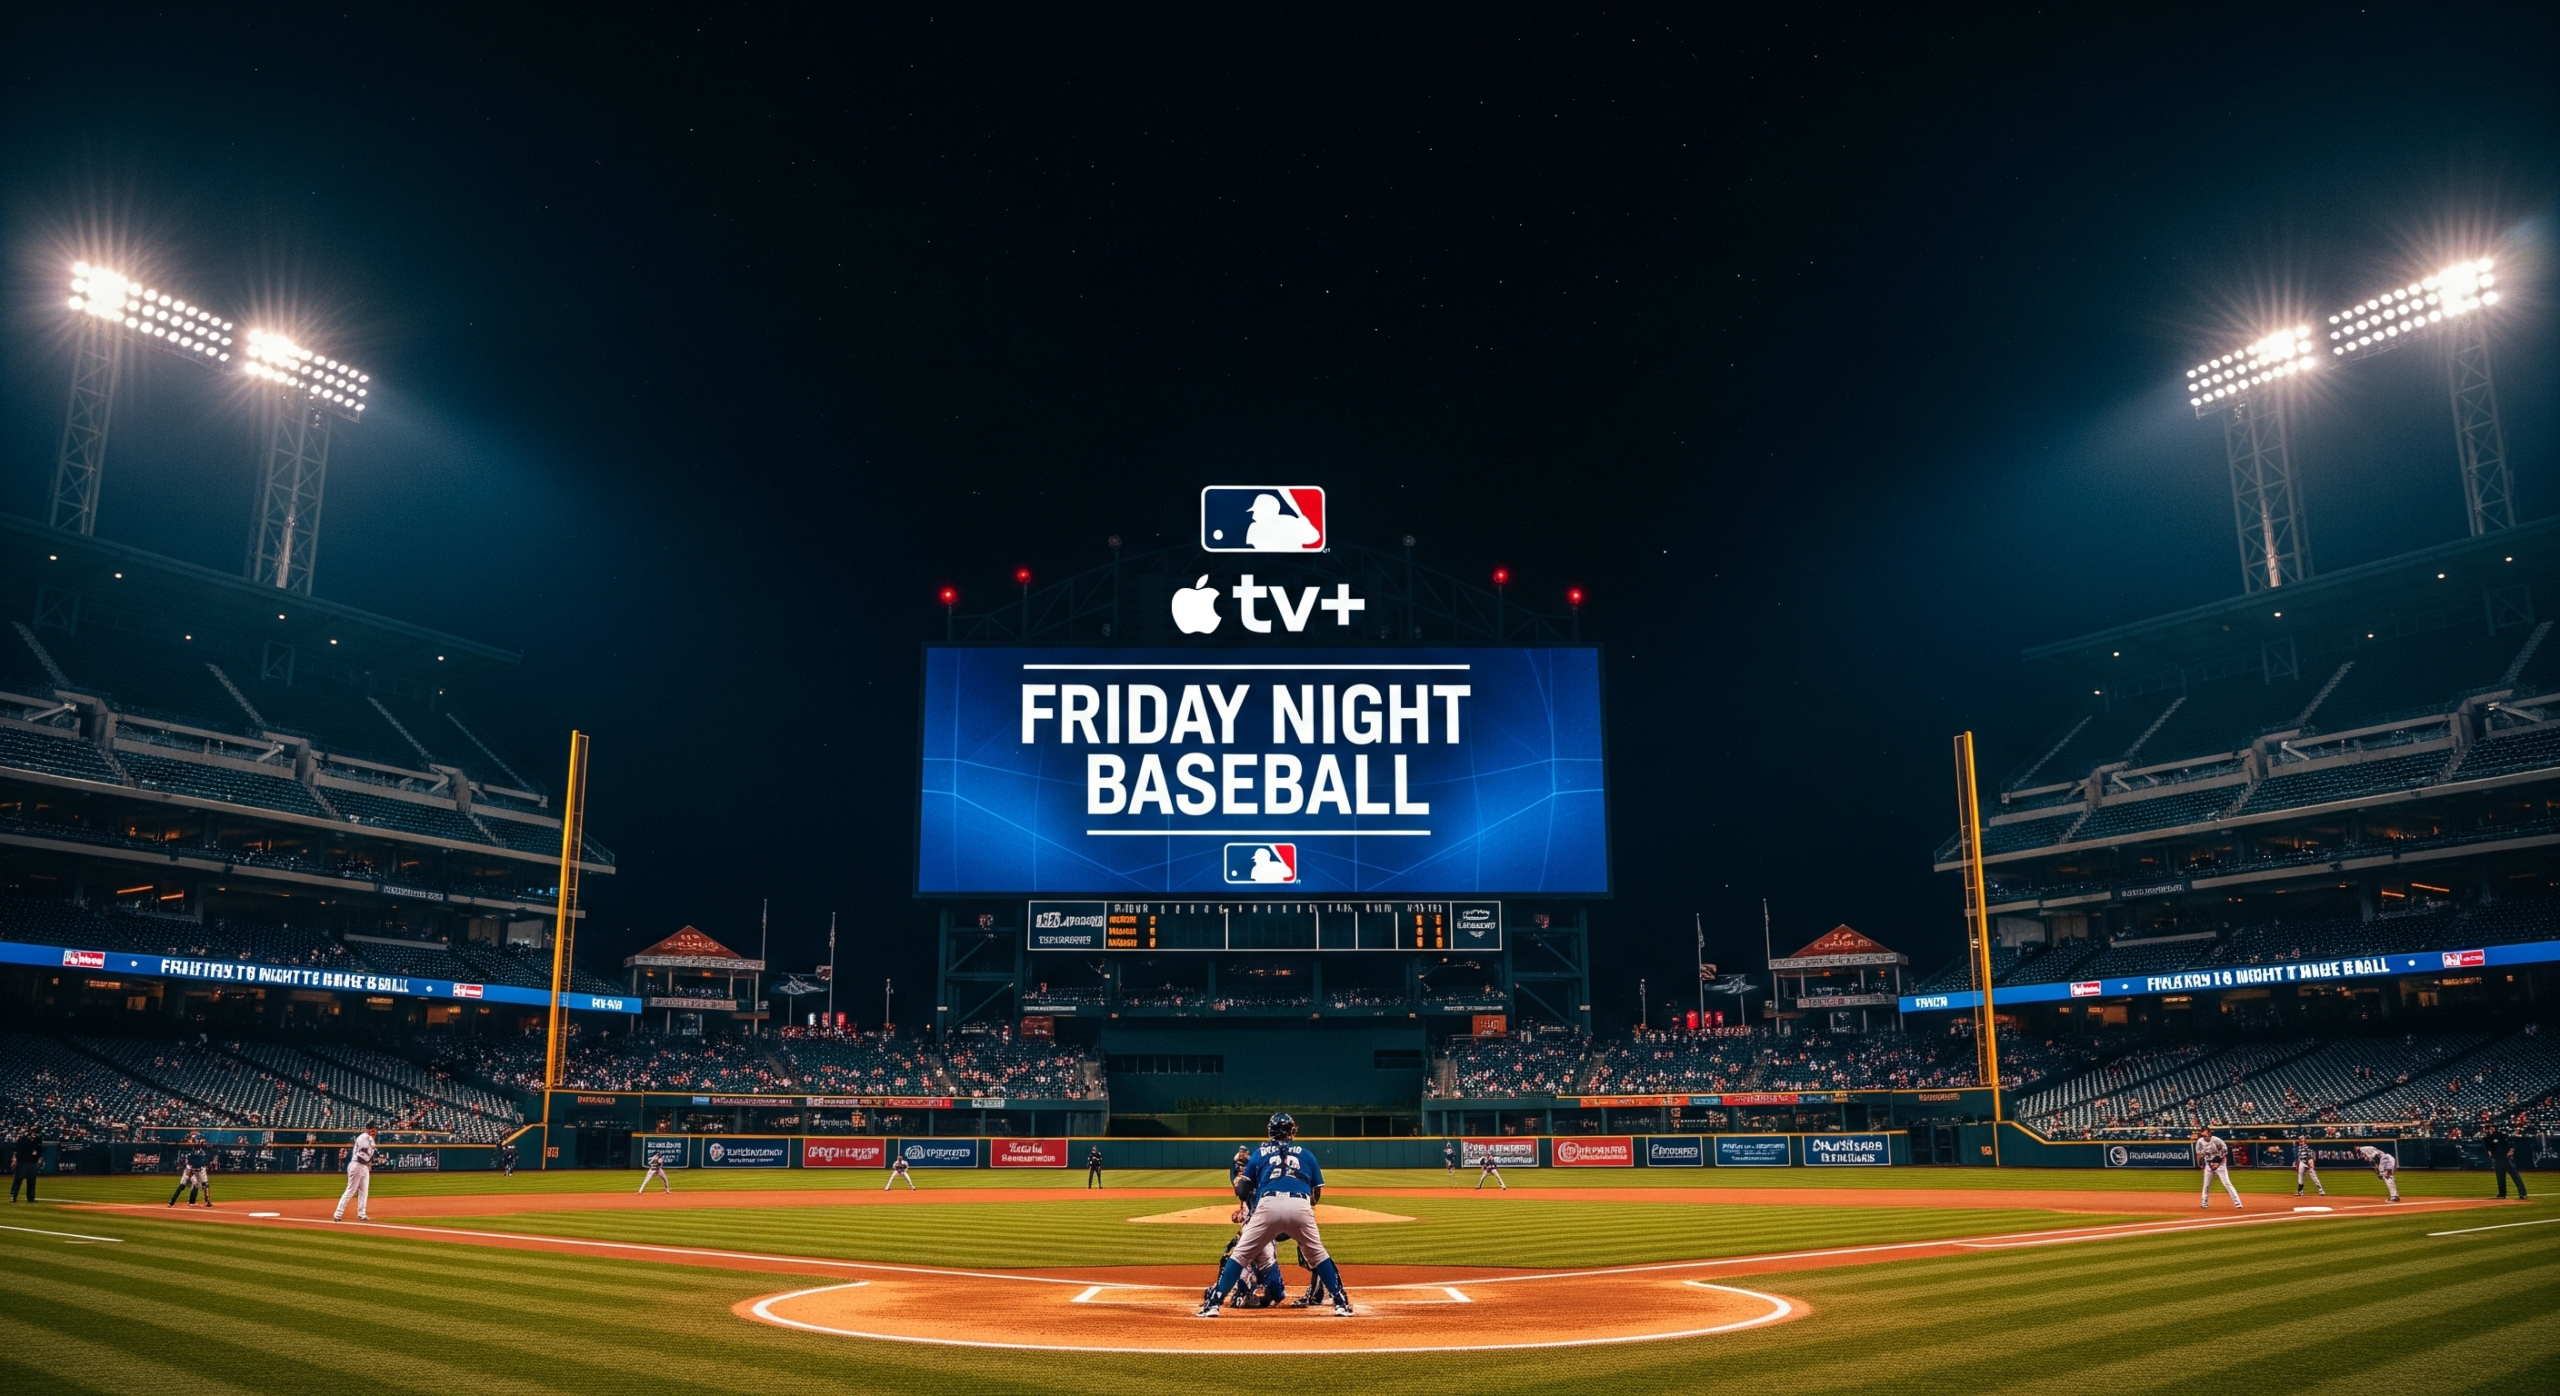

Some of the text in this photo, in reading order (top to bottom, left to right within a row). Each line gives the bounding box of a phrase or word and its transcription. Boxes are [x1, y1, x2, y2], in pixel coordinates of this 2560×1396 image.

[1021, 683, 1471, 745] FRIDAY NIGHT
[1087, 753, 1430, 816] BASEBALL
